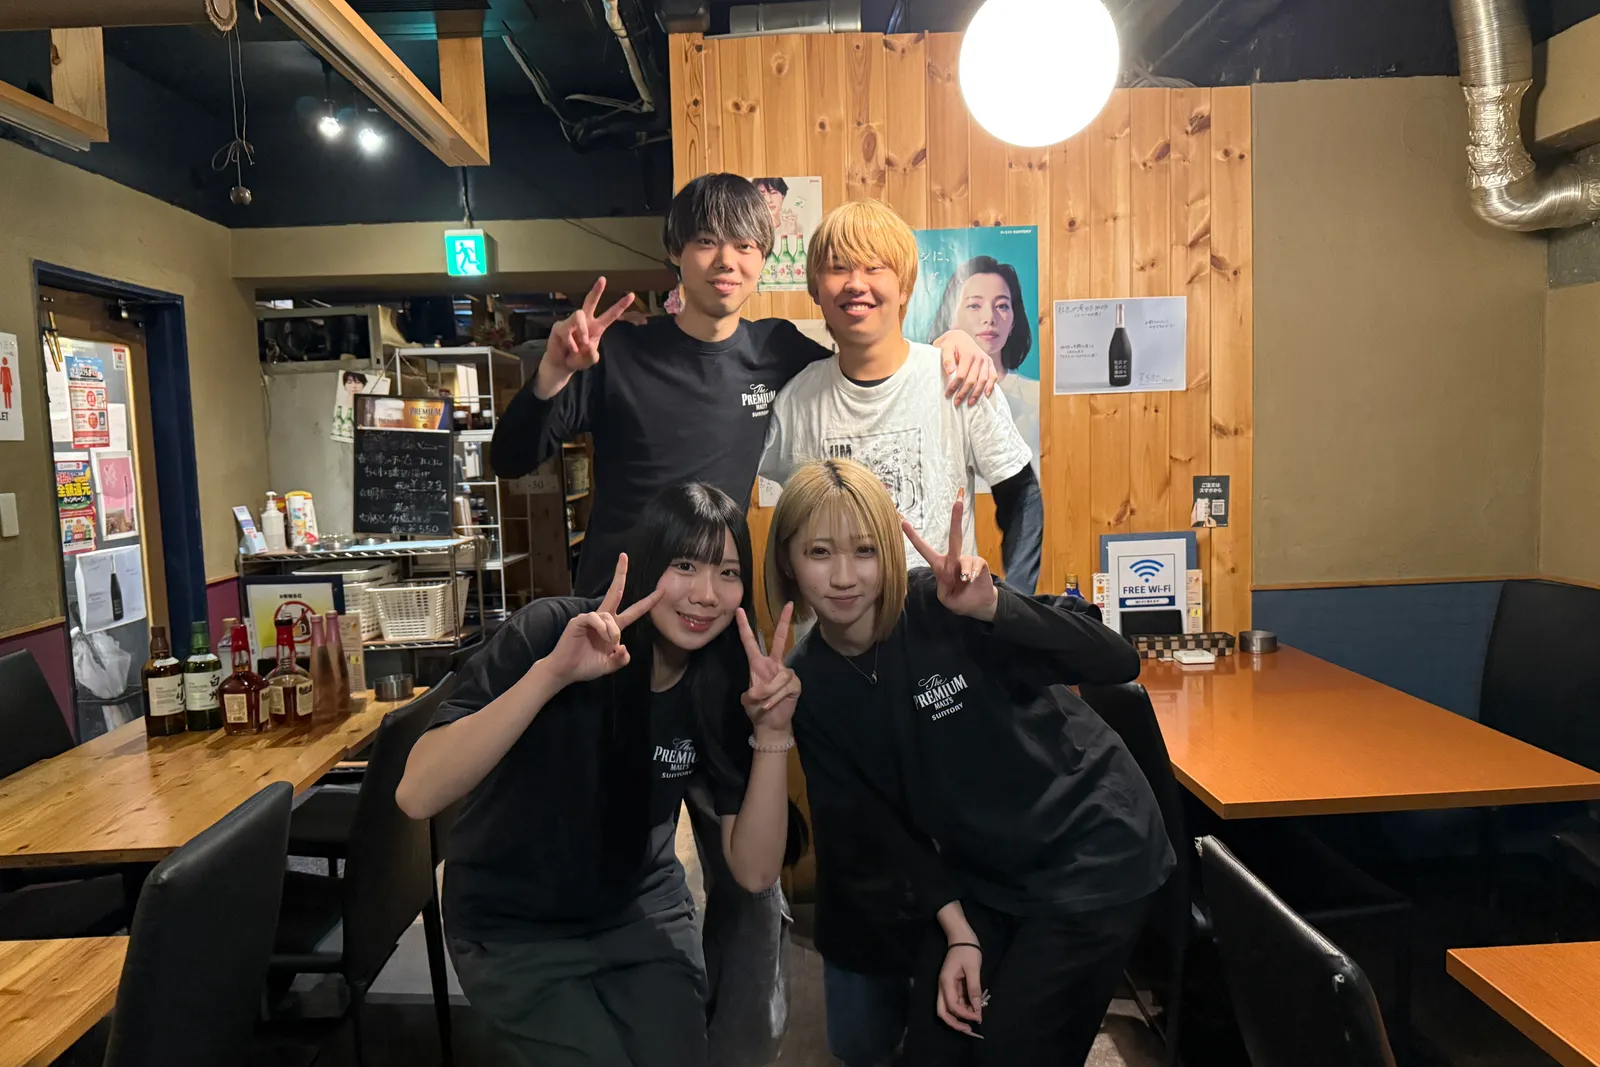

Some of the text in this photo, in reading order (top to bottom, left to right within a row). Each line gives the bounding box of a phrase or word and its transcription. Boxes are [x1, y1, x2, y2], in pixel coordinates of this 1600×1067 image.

[57, 482, 92, 497] 全額還元
[1123, 584, 1171, 594] FREE Wi-Fi
[918, 674, 947, 690] The
[913, 674, 968, 710] PREMIUM
[931, 702, 963, 721] SUNTORY
[673, 738, 694, 750] The
